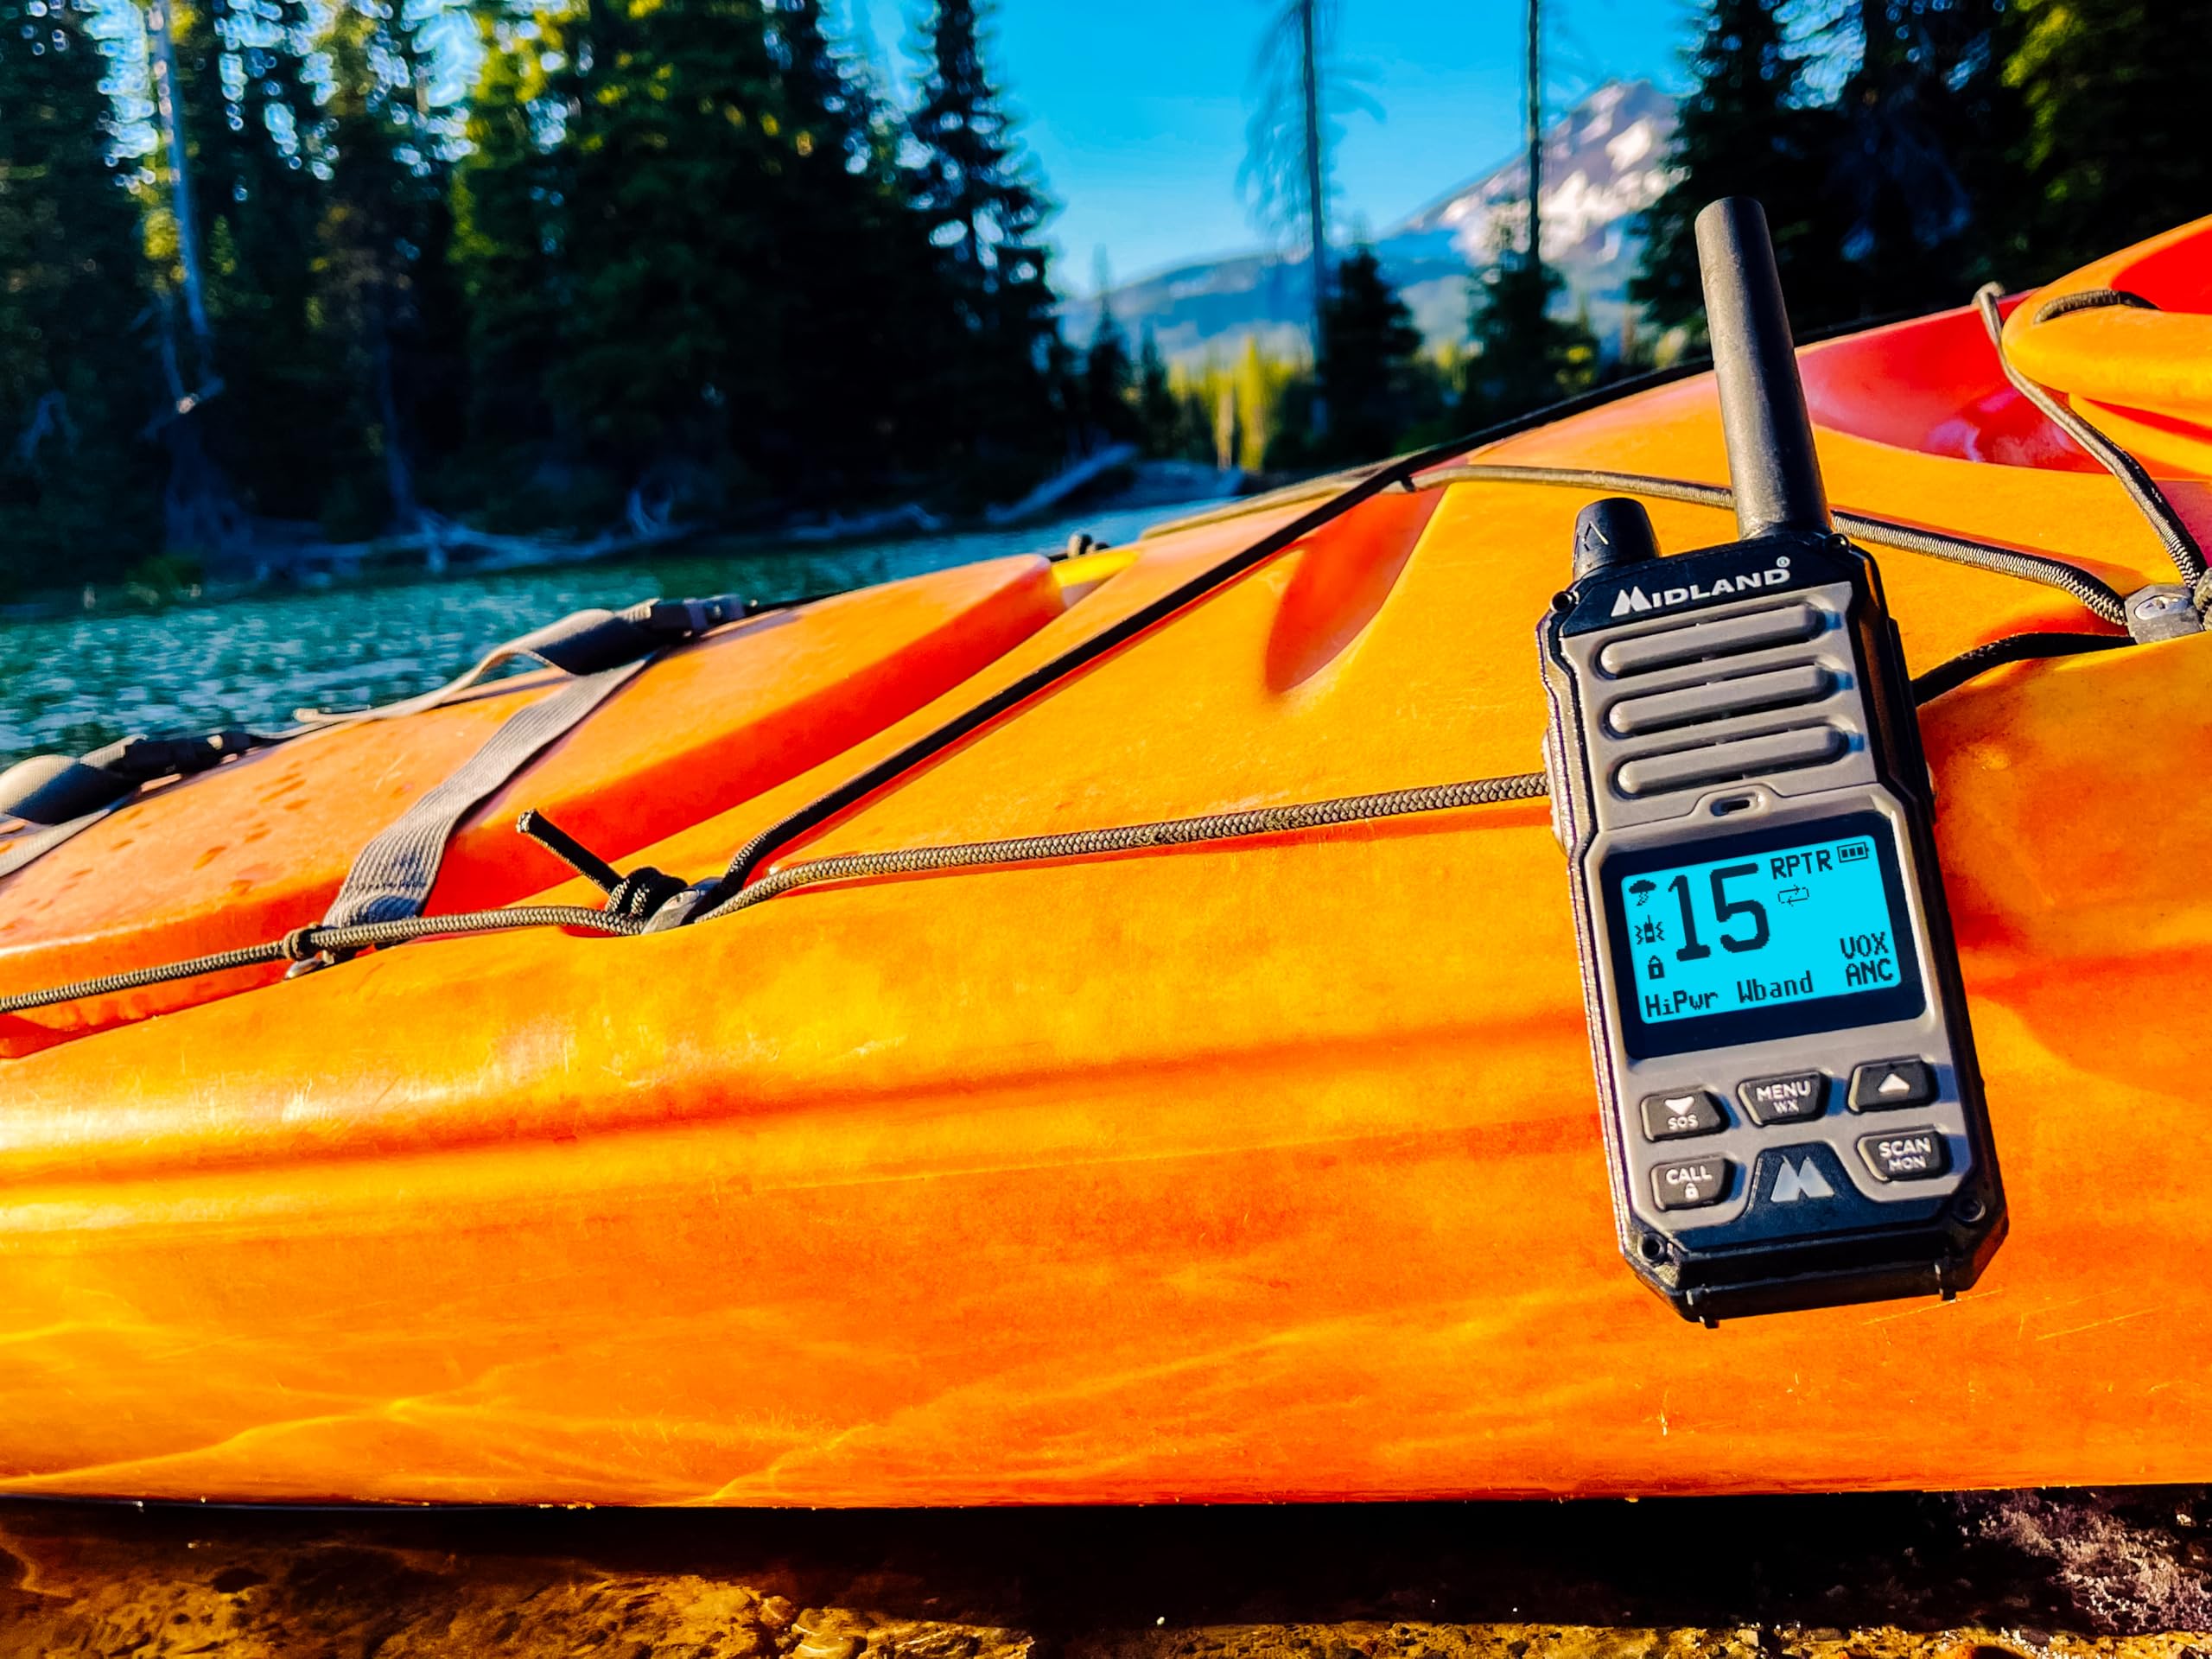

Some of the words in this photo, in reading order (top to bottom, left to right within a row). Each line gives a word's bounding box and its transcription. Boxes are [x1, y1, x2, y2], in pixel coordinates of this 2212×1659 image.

[1770, 849, 1833, 880] RPTR
[1668, 862, 1770, 962] 15
[1840, 931, 1889, 959] VOX
[1845, 958, 1893, 987] ANC
[1645, 989, 1719, 1018] HiPwr
[1737, 970, 1814, 1004] Wband
[1756, 1080, 1811, 1102] MENU
[1773, 1100, 1799, 1114] WX
[1668, 1115, 1699, 1130] SOS
[1878, 1137, 1932, 1158] SCAN
[1665, 1166, 1713, 1185] CALL
